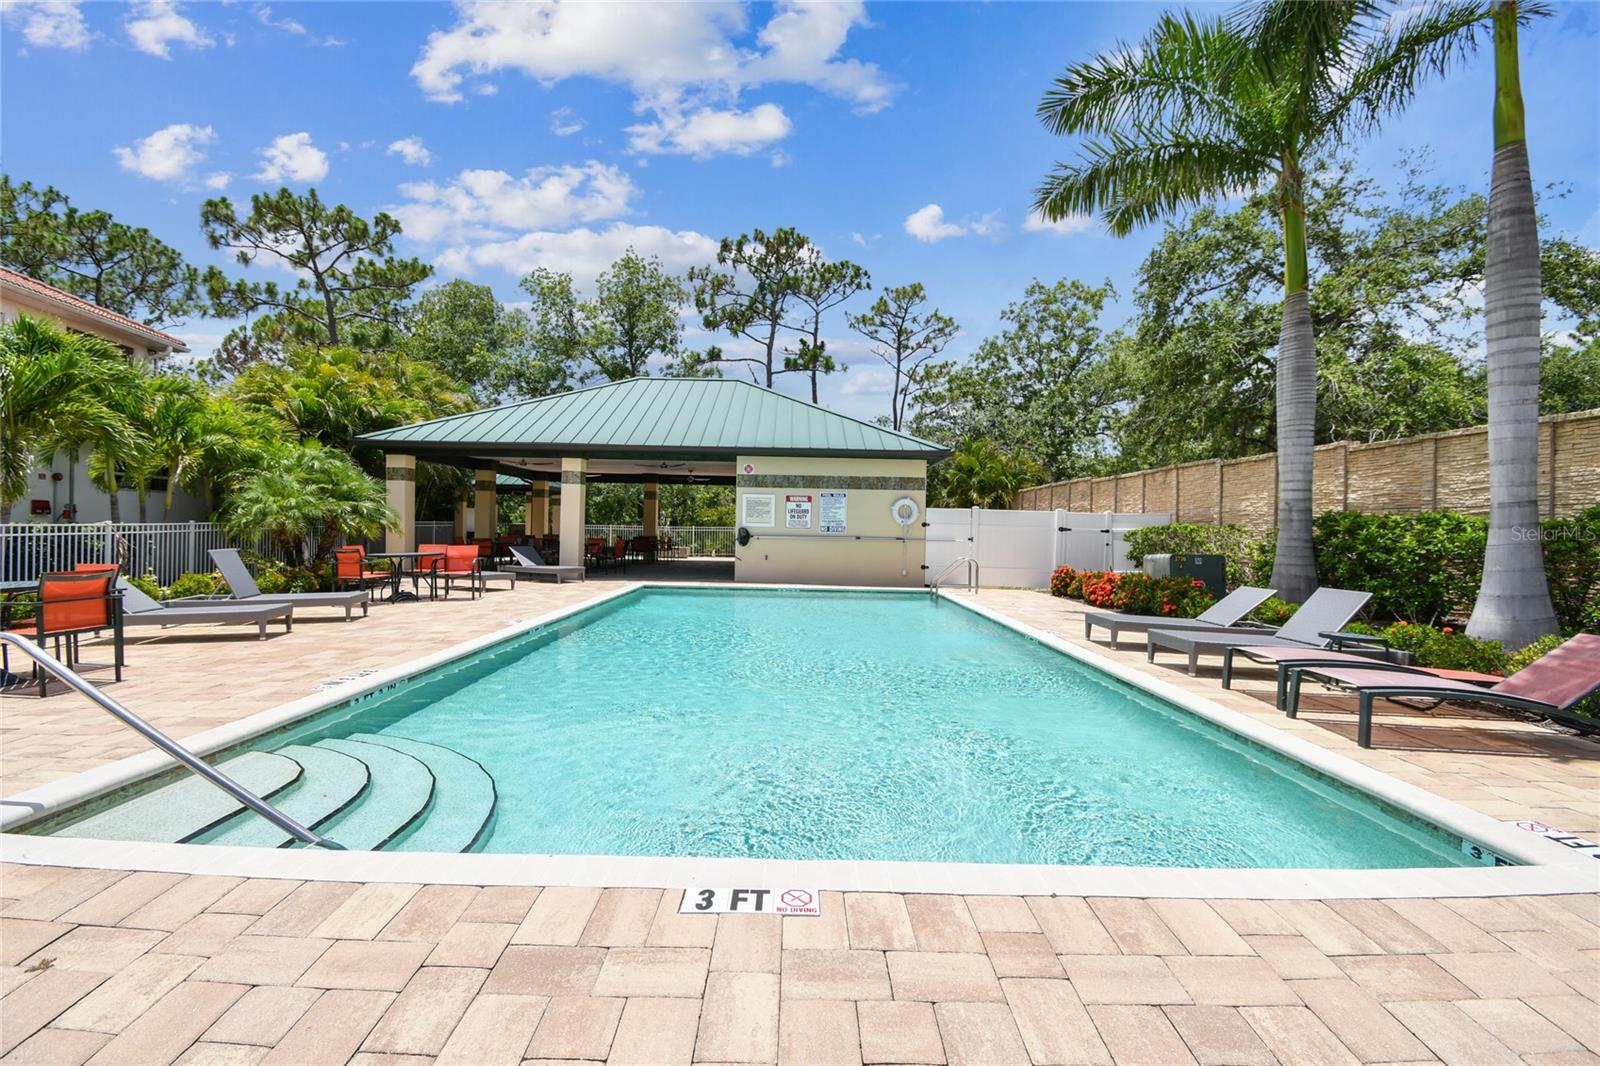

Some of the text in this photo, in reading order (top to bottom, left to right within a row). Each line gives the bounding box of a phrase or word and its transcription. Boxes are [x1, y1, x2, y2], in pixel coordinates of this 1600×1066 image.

[1470, 845, 1483, 860] 3
[695, 889, 770, 911] 3 FT
